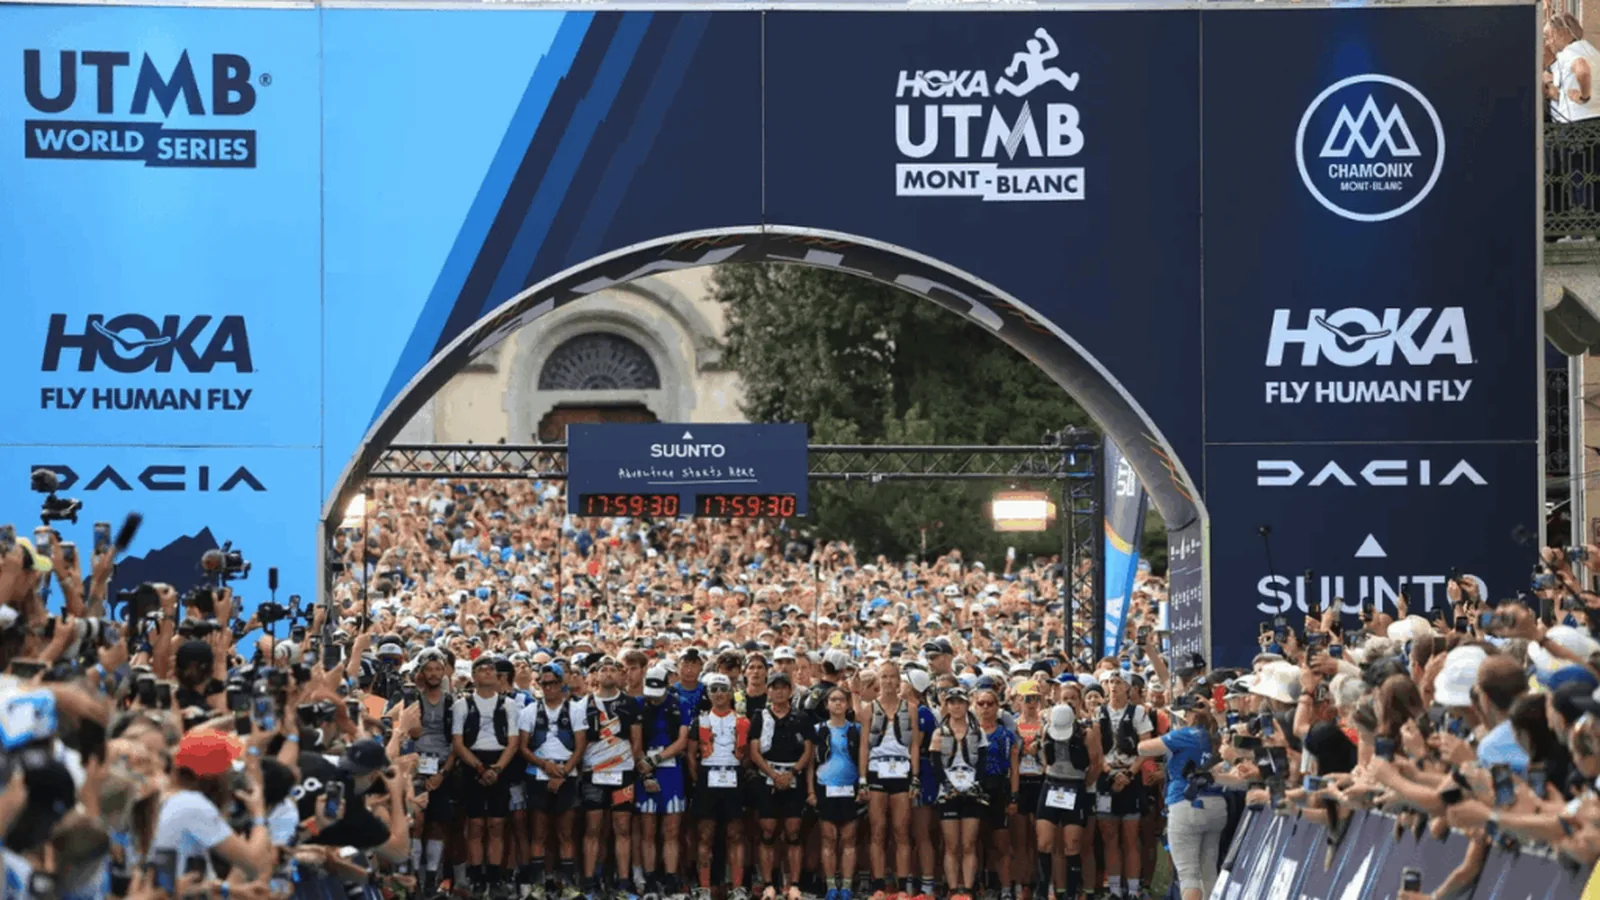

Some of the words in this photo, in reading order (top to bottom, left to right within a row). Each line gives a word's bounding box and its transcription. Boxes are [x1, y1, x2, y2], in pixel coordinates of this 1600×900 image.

[895, 70, 990, 98] HOKA
[895, 100, 1085, 160] UTMB
[34, 128, 145, 153] WORLD
[157, 137, 249, 161] SERIES
[1328, 162, 1413, 179] CHAMONIX
[41, 313, 254, 374] HOKA
[1265, 307, 1473, 367] HOKA
[41, 388, 86, 410] FLY
[92, 388, 202, 411] HUMAN
[207, 388, 253, 411] FLY
[1265, 381, 1310, 403] FLY
[1315, 381, 1422, 403] HUMAN
[1427, 379, 1473, 402] FLY
[650, 443, 726, 458] SUUNTO
[1257, 459, 1488, 486] DACIA
[587, 495, 678, 516] 17:59:30
[704, 495, 795, 517] 17:59:30
